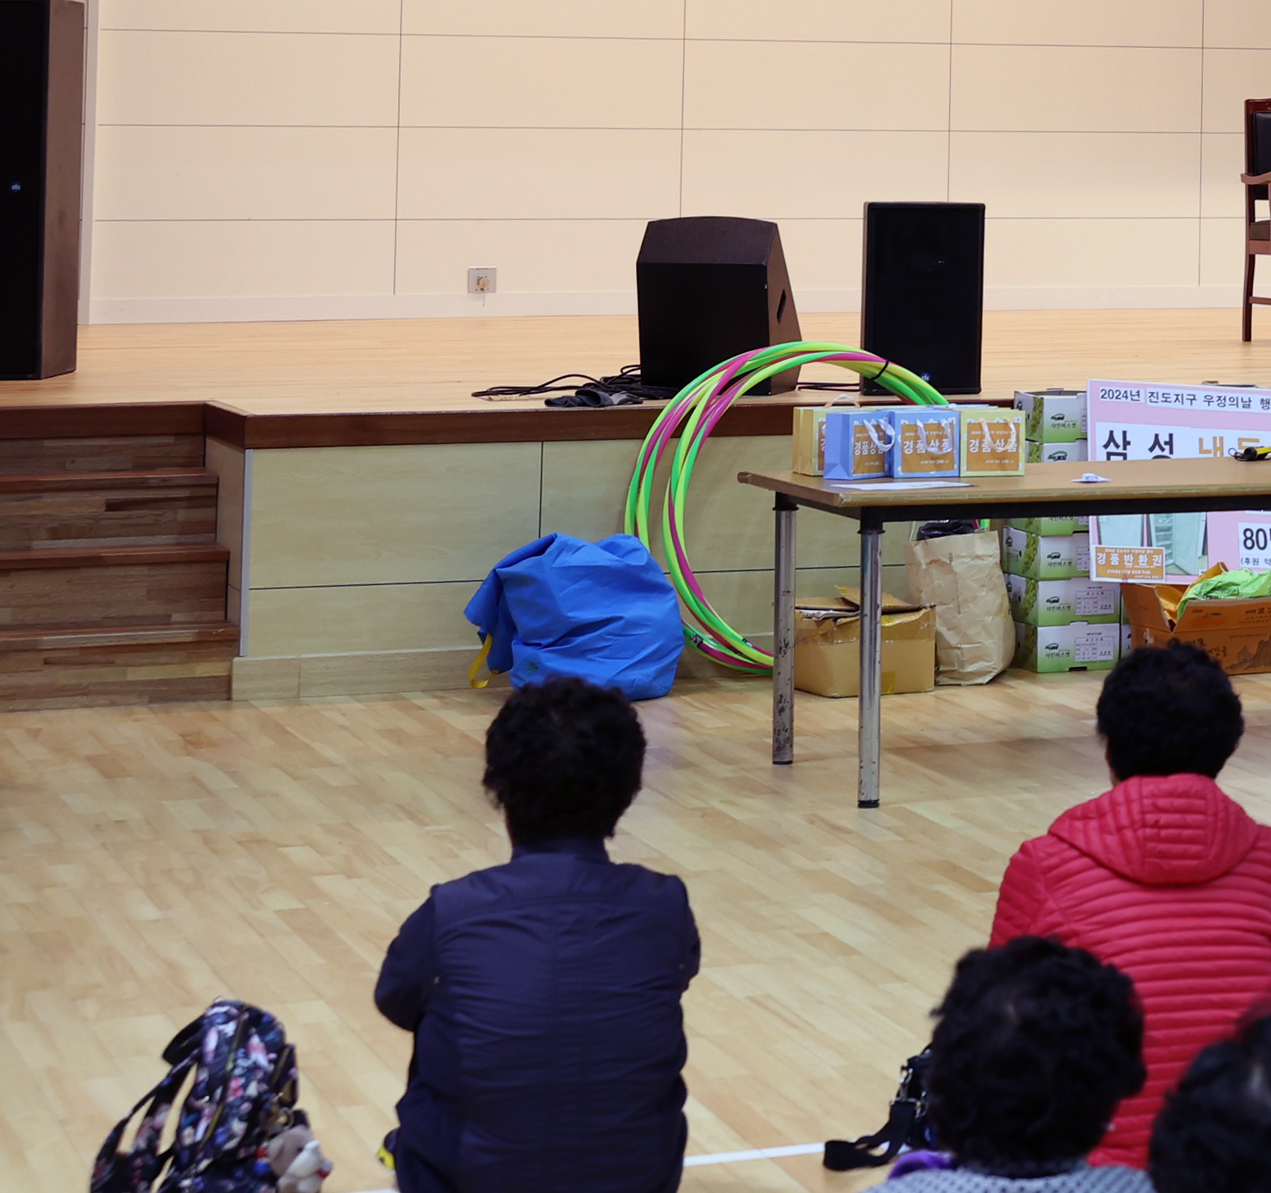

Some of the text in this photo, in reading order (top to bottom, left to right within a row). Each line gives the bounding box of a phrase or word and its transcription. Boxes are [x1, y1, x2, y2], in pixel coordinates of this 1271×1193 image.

[1100, 388, 1141, 402] 2024년
[1148, 391, 1198, 406] 진도지구
[1202, 394, 1252, 409] 우정의날
